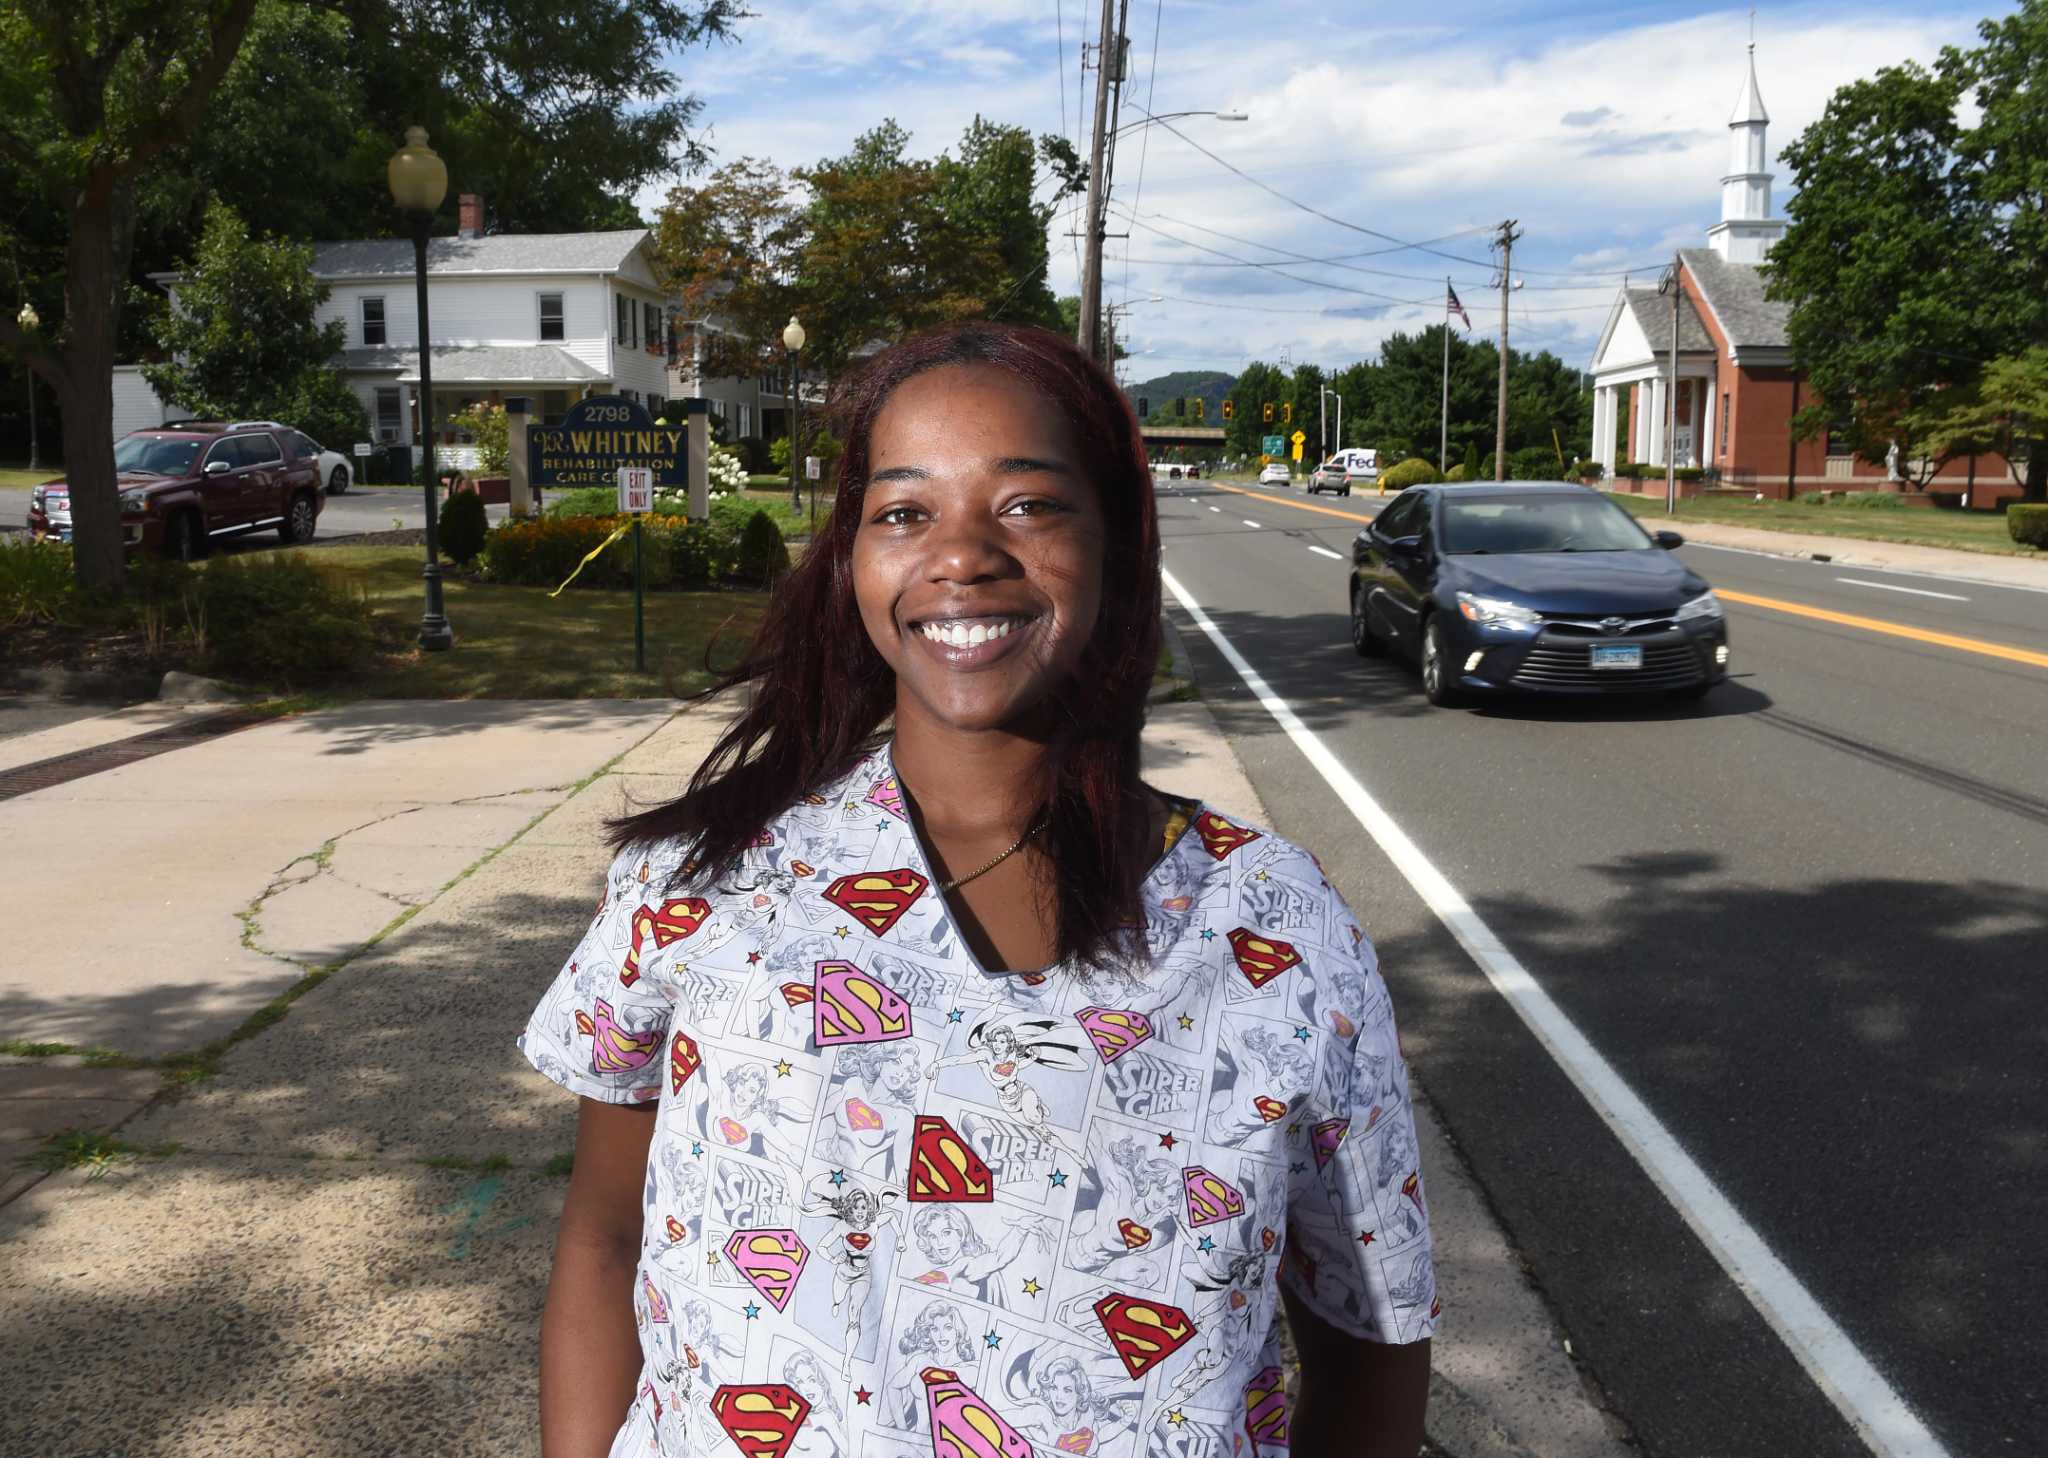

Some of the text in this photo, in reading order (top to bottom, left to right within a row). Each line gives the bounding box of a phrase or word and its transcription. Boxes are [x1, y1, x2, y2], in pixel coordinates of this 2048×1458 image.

[585, 406, 630, 422] 2798
[570, 431, 682, 454] WHITNEY
[543, 458, 674, 470] REHABILITATION
[556, 472, 597, 483] CARE
[629, 472, 646, 489] EXIT
[629, 491, 647, 508] ONLY
[1255, 887, 1324, 915] SUPER
[1148, 914, 1202, 933] UPER
[1260, 911, 1311, 930] GIRL
[1115, 1060, 1201, 1098] SUPER
[1125, 1092, 1179, 1119] GIRL
[971, 1127, 1055, 1162] SUPER
[722, 1172, 790, 1210] SUPER
[731, 1204, 779, 1229] GIRL
